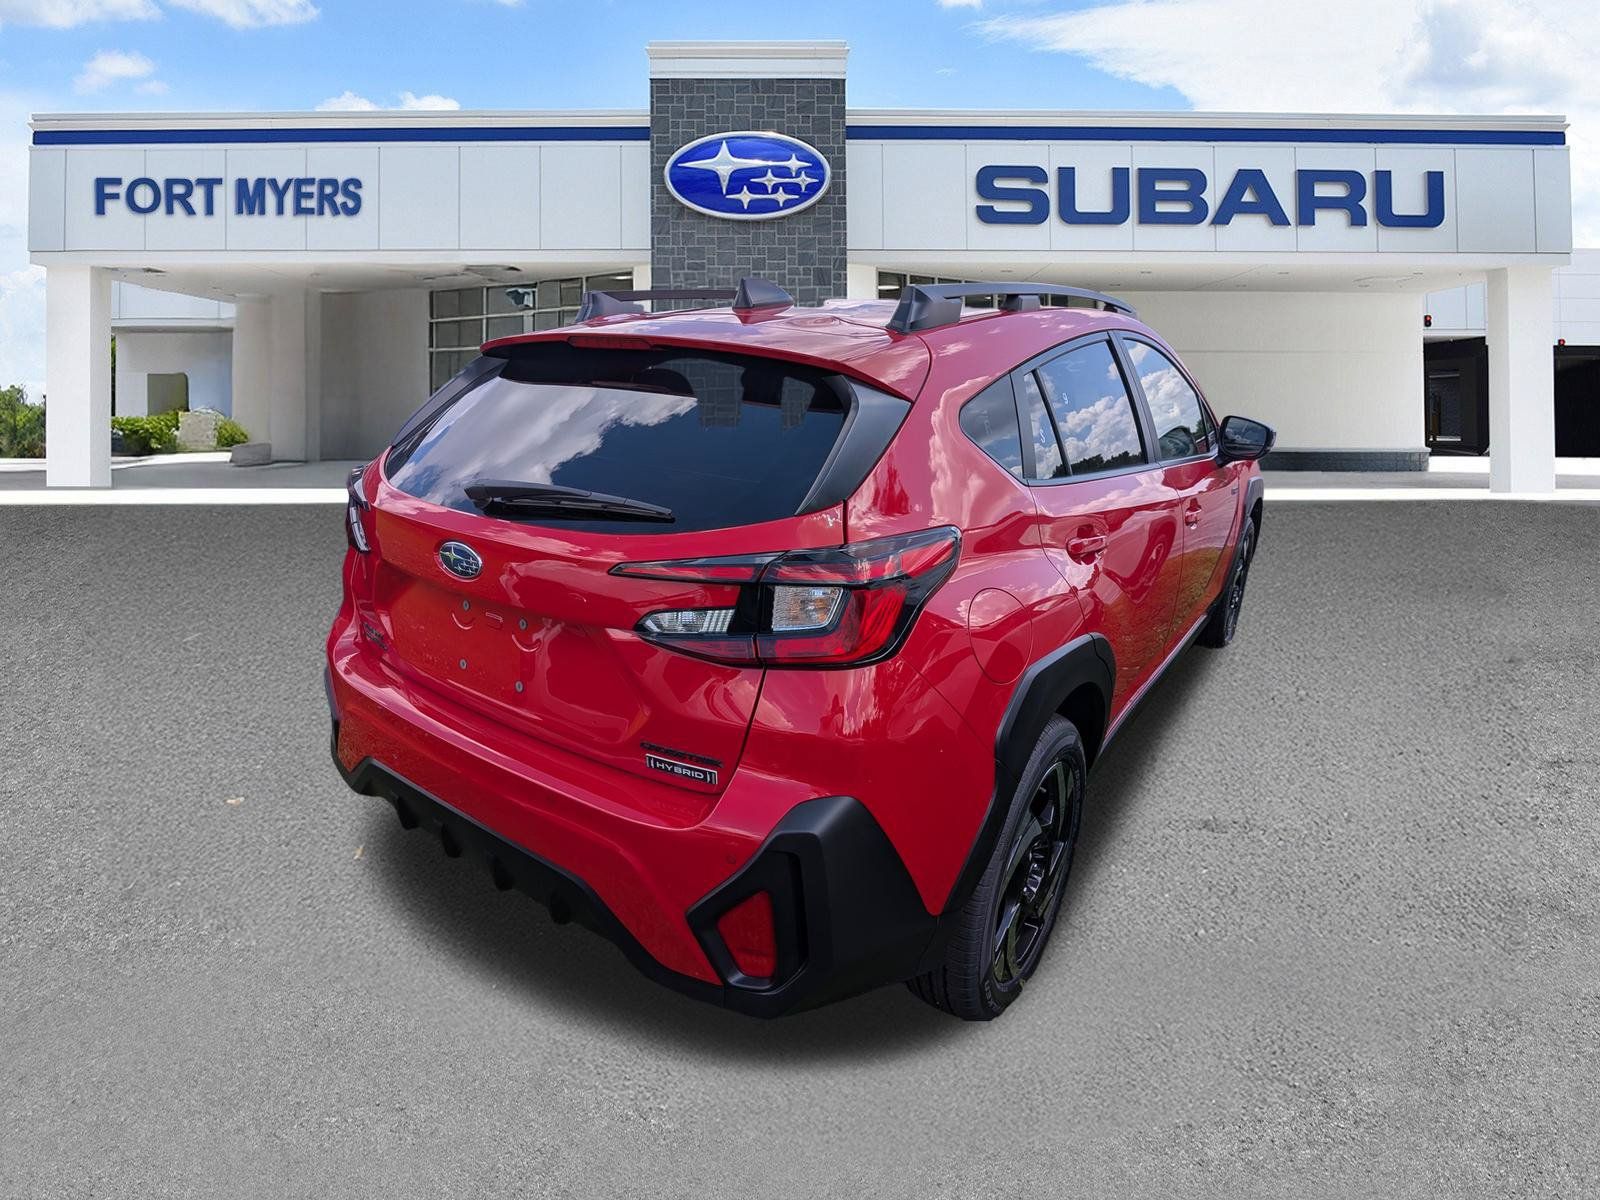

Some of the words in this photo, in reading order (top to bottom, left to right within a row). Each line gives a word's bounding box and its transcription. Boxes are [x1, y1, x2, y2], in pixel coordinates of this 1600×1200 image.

[94, 177, 223, 216] FORT
[235, 177, 363, 216] MYERS
[975, 165, 1446, 228] SUBARU
[656, 761, 704, 779] HYBRID
